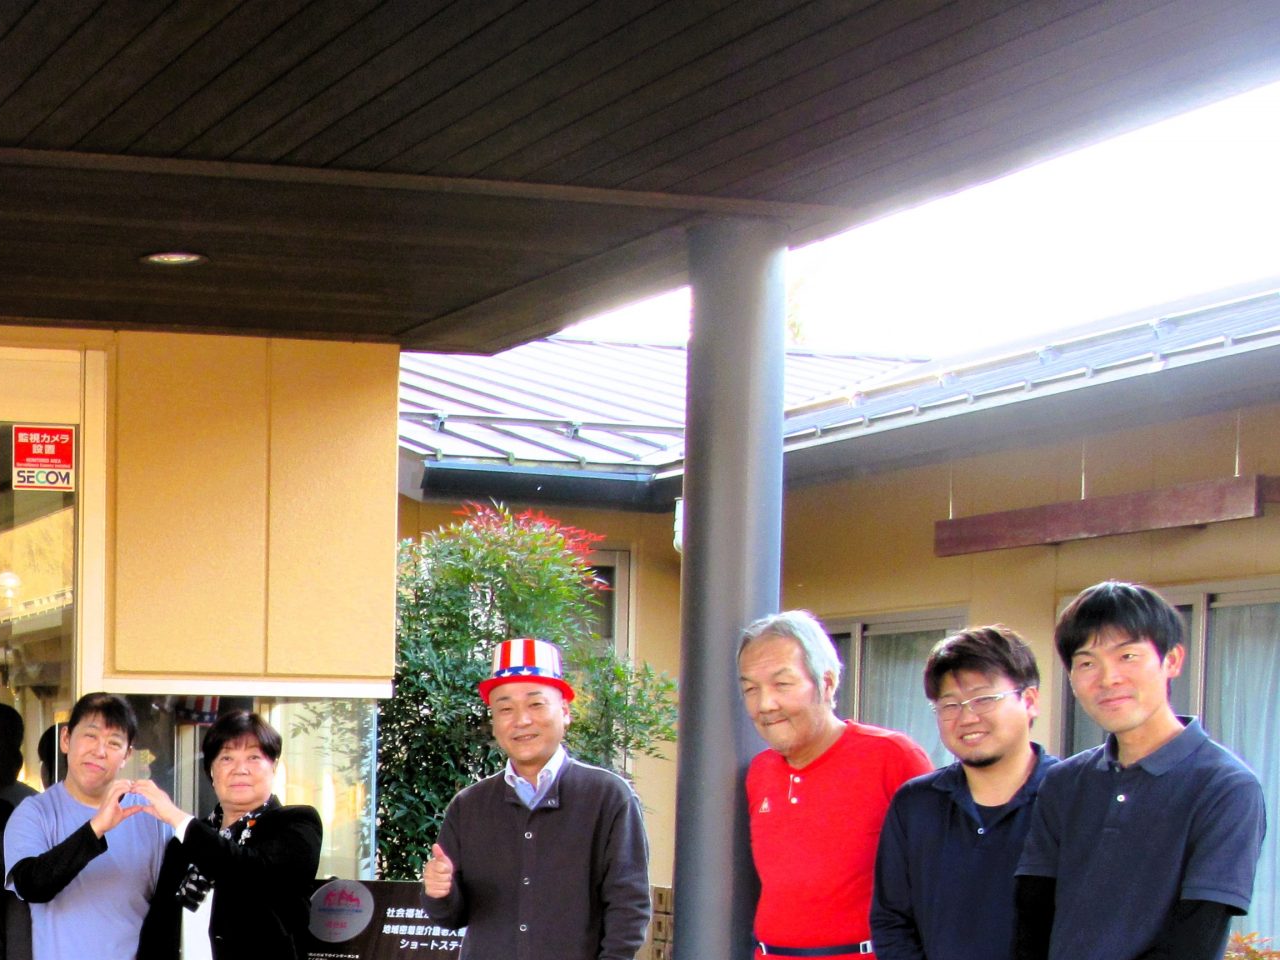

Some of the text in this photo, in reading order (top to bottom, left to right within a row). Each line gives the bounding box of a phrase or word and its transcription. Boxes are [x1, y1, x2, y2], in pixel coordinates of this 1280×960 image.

[18, 432, 69, 443] 監視カメラ
[17, 470, 70, 484] SECOM
[386, 908, 429, 918] 社会福祉
[400, 939, 462, 950] ショートステ
